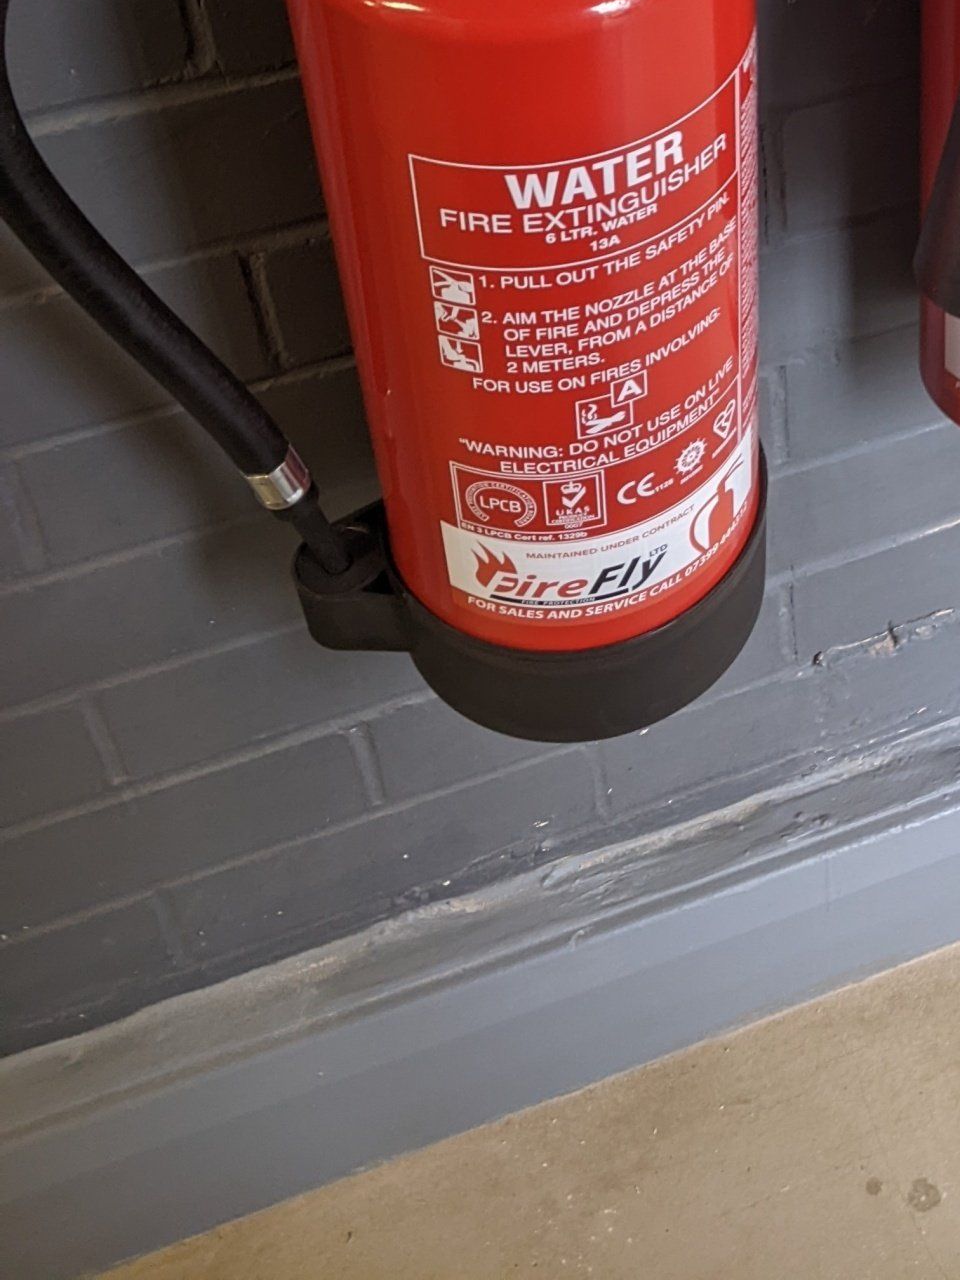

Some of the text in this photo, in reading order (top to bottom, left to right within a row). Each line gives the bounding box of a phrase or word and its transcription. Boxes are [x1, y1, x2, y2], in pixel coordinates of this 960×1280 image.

[440, 132, 727, 235] FIRE EXTINGUISHER
[504, 130, 684, 211] WATER
[545, 203, 658, 245] 6 LTR. WATER
[590, 236, 621, 253] 13A
[479, 276, 495, 289] 1.
[500, 274, 552, 290] PULL
[556, 266, 600, 287] OUT
[602, 254, 641, 275] THE
[644, 217, 706, 260] SAFETY
[481, 216, 737, 325] 2. AIM THE NOZZLE AT THE BASE
[504, 246, 726, 343] OF FIRE AND DEPRESS THE
[505, 252, 734, 359] LEVER, FROM A DISTANCE OF
[472, 377, 510, 393] FOR
[515, 380, 553, 393] USE
[558, 376, 587, 391] ON
[590, 360, 642, 386] FIRES
[507, 354, 605, 374] 2 METERS.
[568, 439, 599, 455] DO
[603, 426, 644, 449] NOT
[647, 406, 681, 432] USE
[684, 388, 707, 411] ON
[708, 356, 733, 393] LIVE
[617, 379, 642, 402] A
[500, 452, 623, 475] ELECTRICAL
[480, 496, 522, 513] LPCB
[461, 522, 476, 532] EN
[484, 528, 512, 538] LPCB
[514, 532, 537, 541] Cert
[526, 504, 695, 560] MAINTAINED UNDER CONTRACT
[650, 543, 668, 557] LTD
[468, 596, 496, 614] FOR
[498, 606, 544, 620] SALES
[547, 607, 583, 620] AND
[585, 592, 648, 617] SERVICE
[650, 574, 683, 598] CALL
